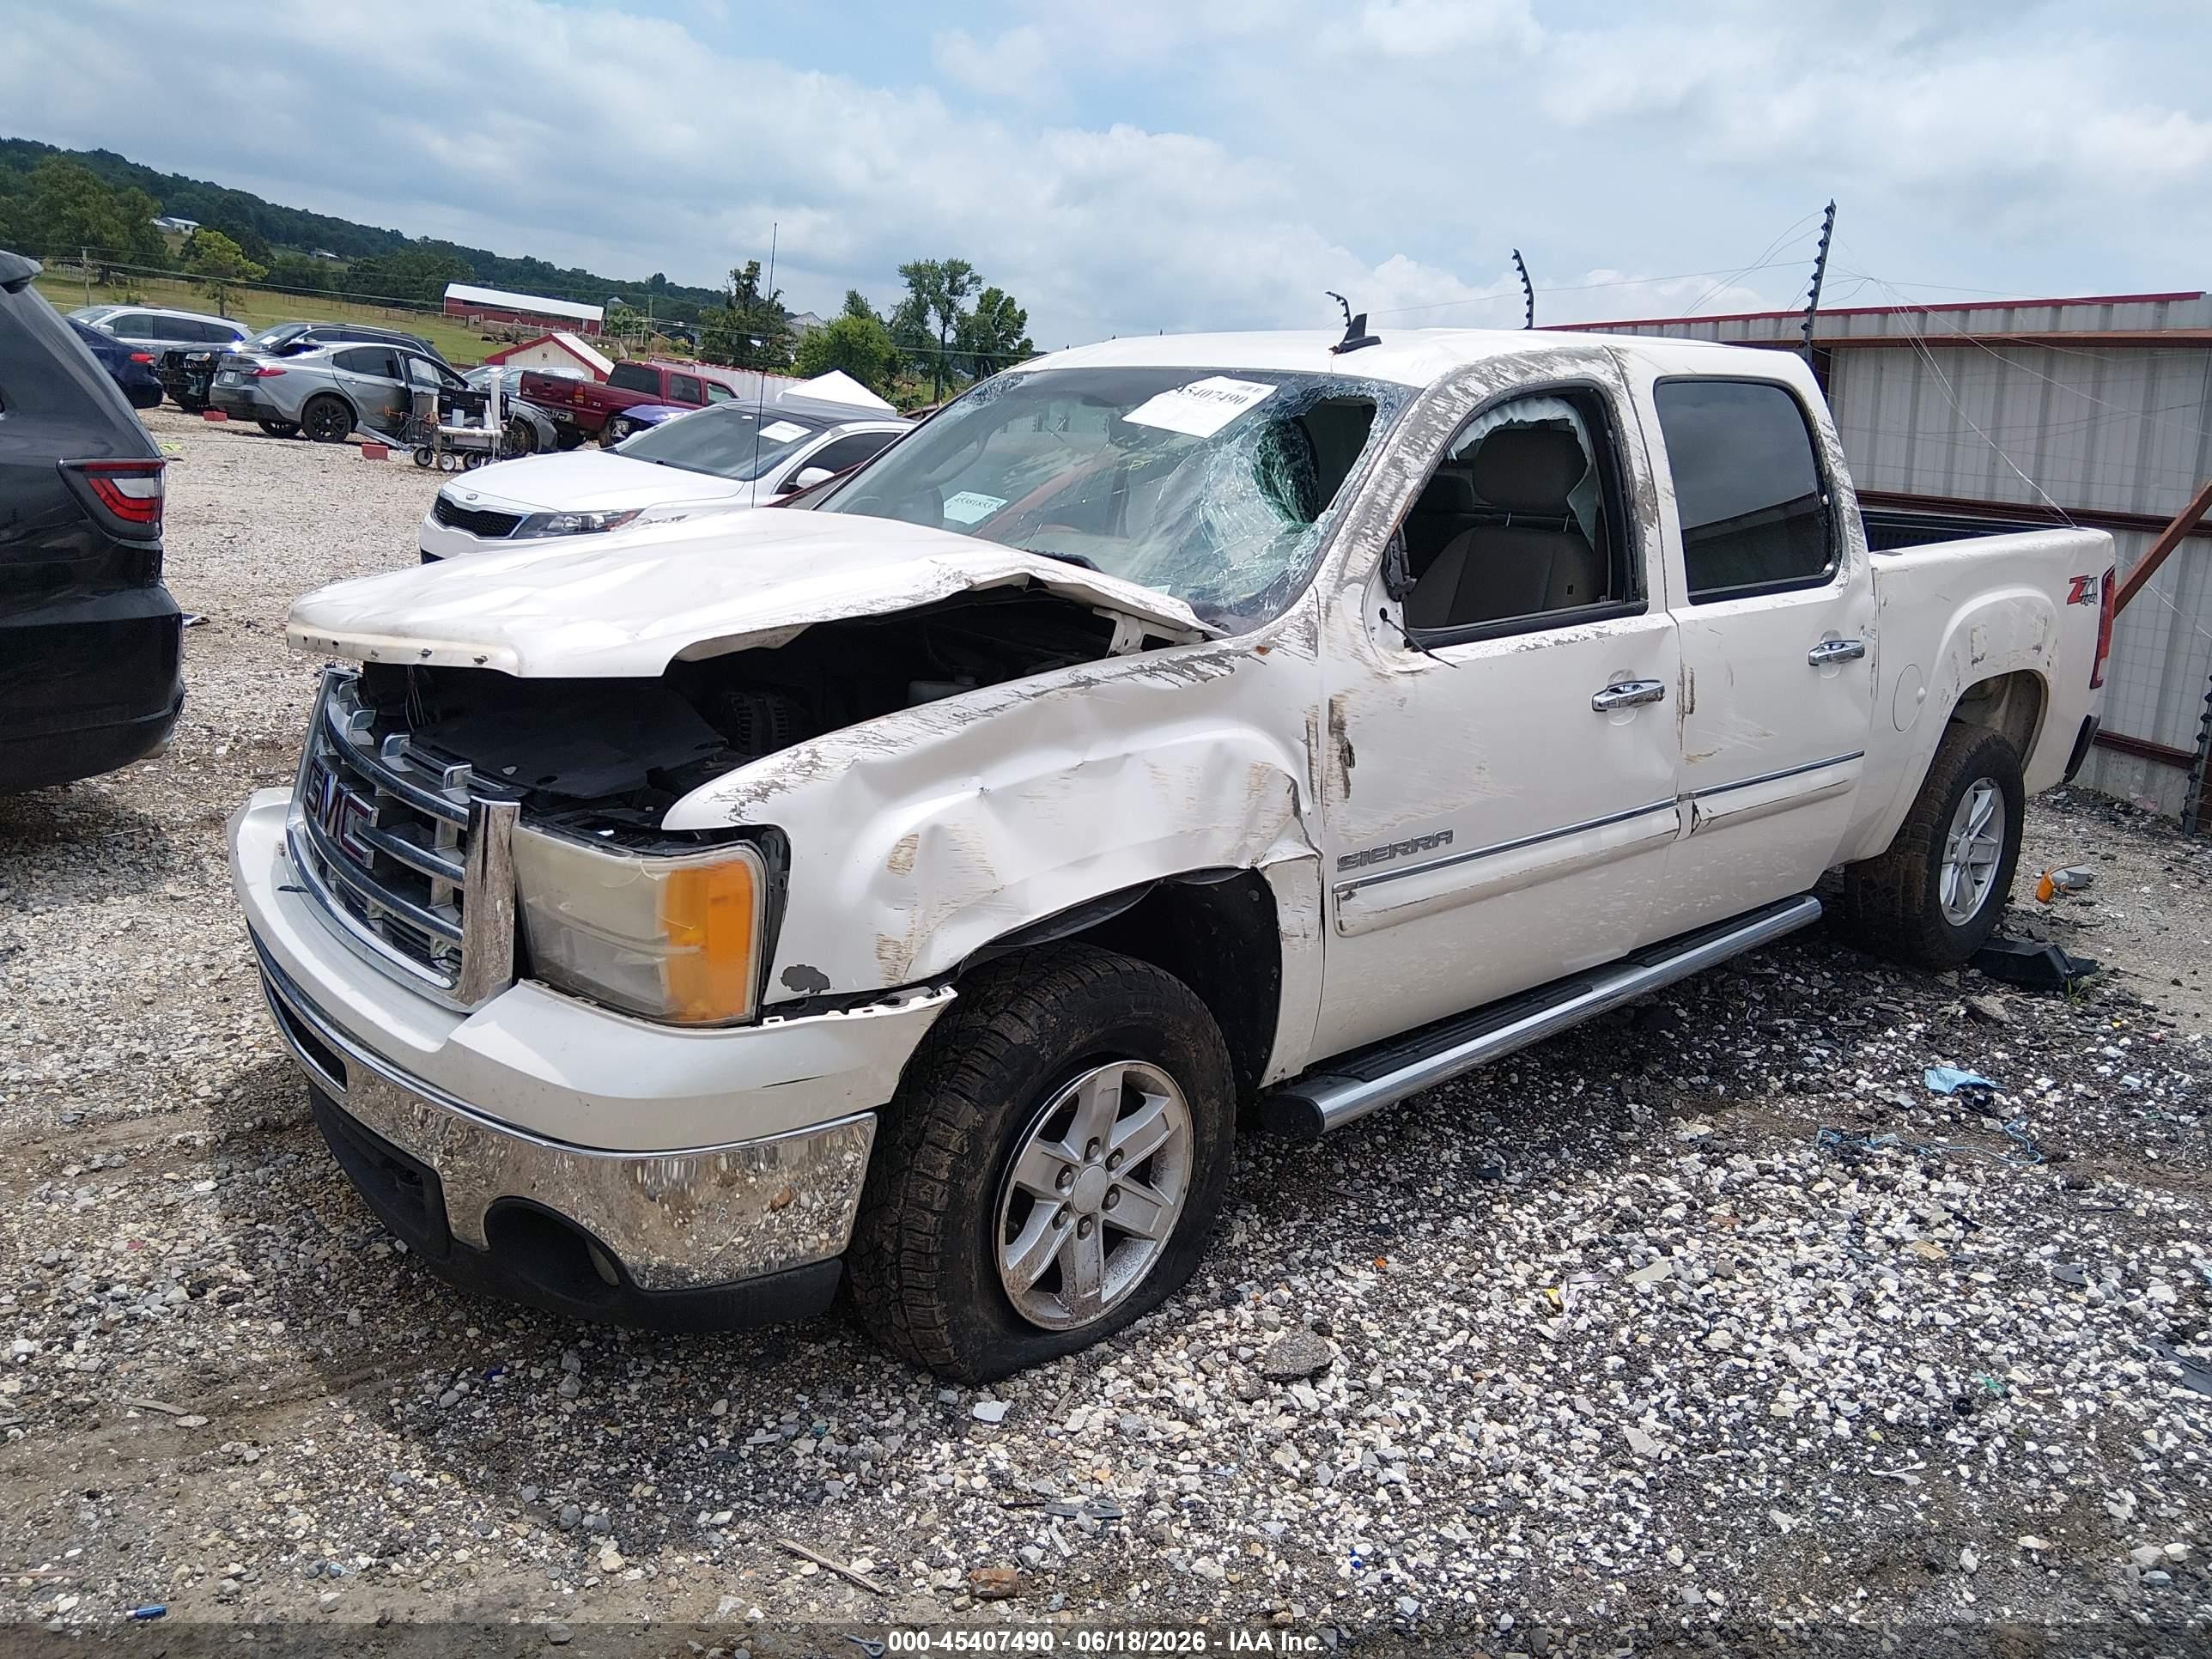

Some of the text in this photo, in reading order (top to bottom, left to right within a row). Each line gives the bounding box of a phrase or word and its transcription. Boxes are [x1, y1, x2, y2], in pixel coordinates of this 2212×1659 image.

[2067, 574, 2098, 605] Z71
[306, 755, 380, 869] GMC
[1337, 828, 1454, 872] SIERRA
